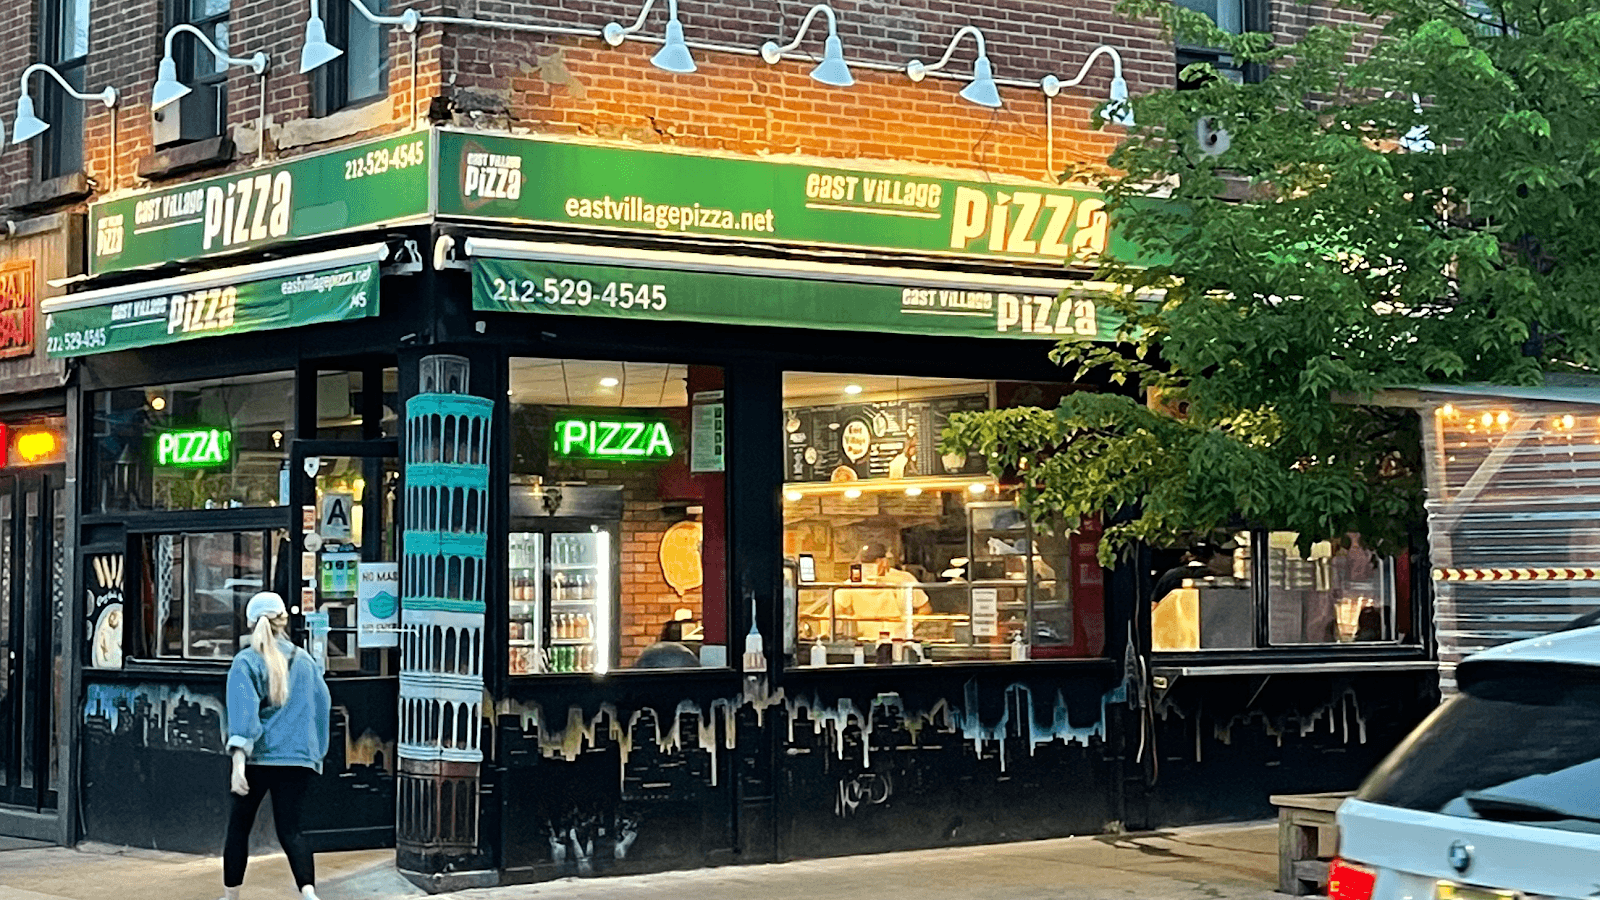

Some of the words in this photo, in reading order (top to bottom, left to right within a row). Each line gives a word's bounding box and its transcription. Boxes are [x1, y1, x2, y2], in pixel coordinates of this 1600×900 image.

[345, 140, 424, 180] 212-529-4545
[564, 196, 775, 233] eastvillagepizza.net
[493, 277, 668, 311] 212-529-4545
[46, 326, 107, 353] 212529-4545
[158, 428, 223, 465] PIZZA
[560, 419, 674, 456] PIZZA
[326, 498, 348, 526] A
[376, 571, 399, 582] MAS
